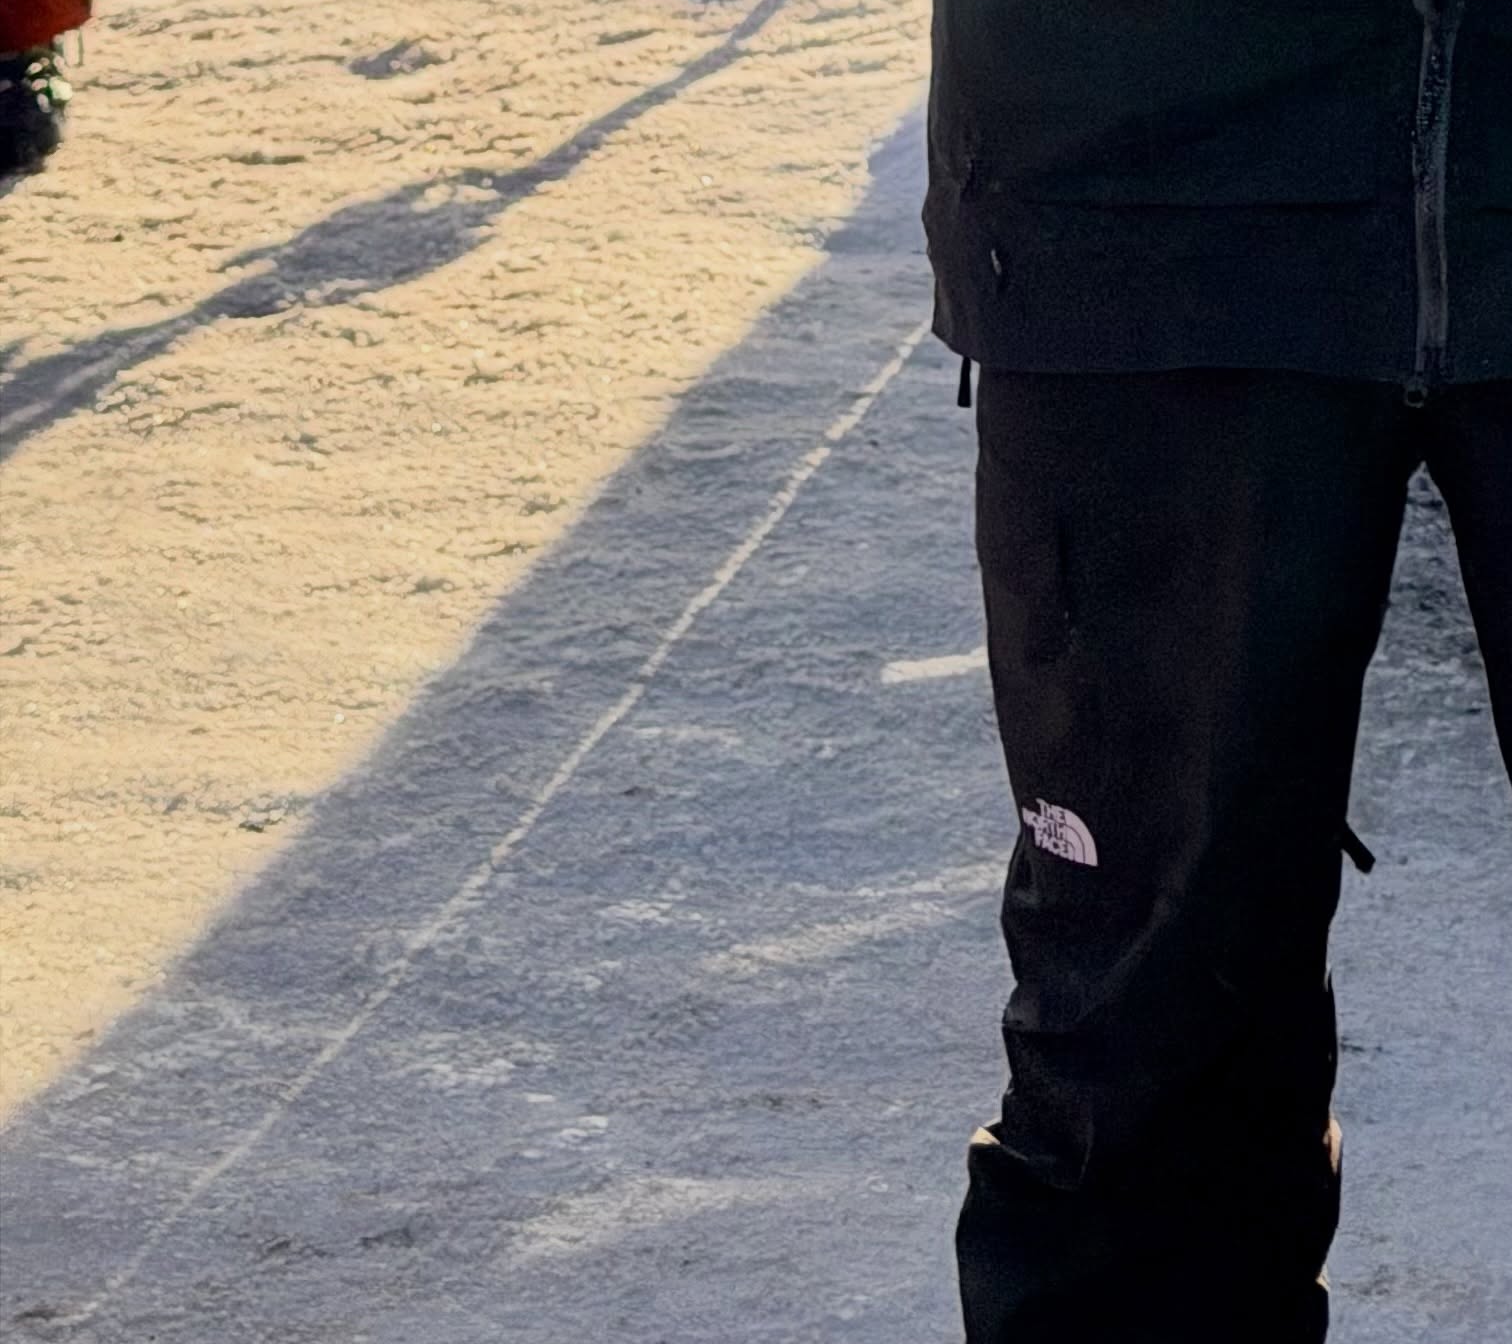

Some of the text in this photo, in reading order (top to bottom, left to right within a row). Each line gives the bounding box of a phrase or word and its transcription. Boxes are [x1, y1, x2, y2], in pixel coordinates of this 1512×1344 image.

[1021, 806, 1067, 842] NORTH
[1035, 797, 1067, 824] THE
[1033, 825, 1071, 861] FACE
